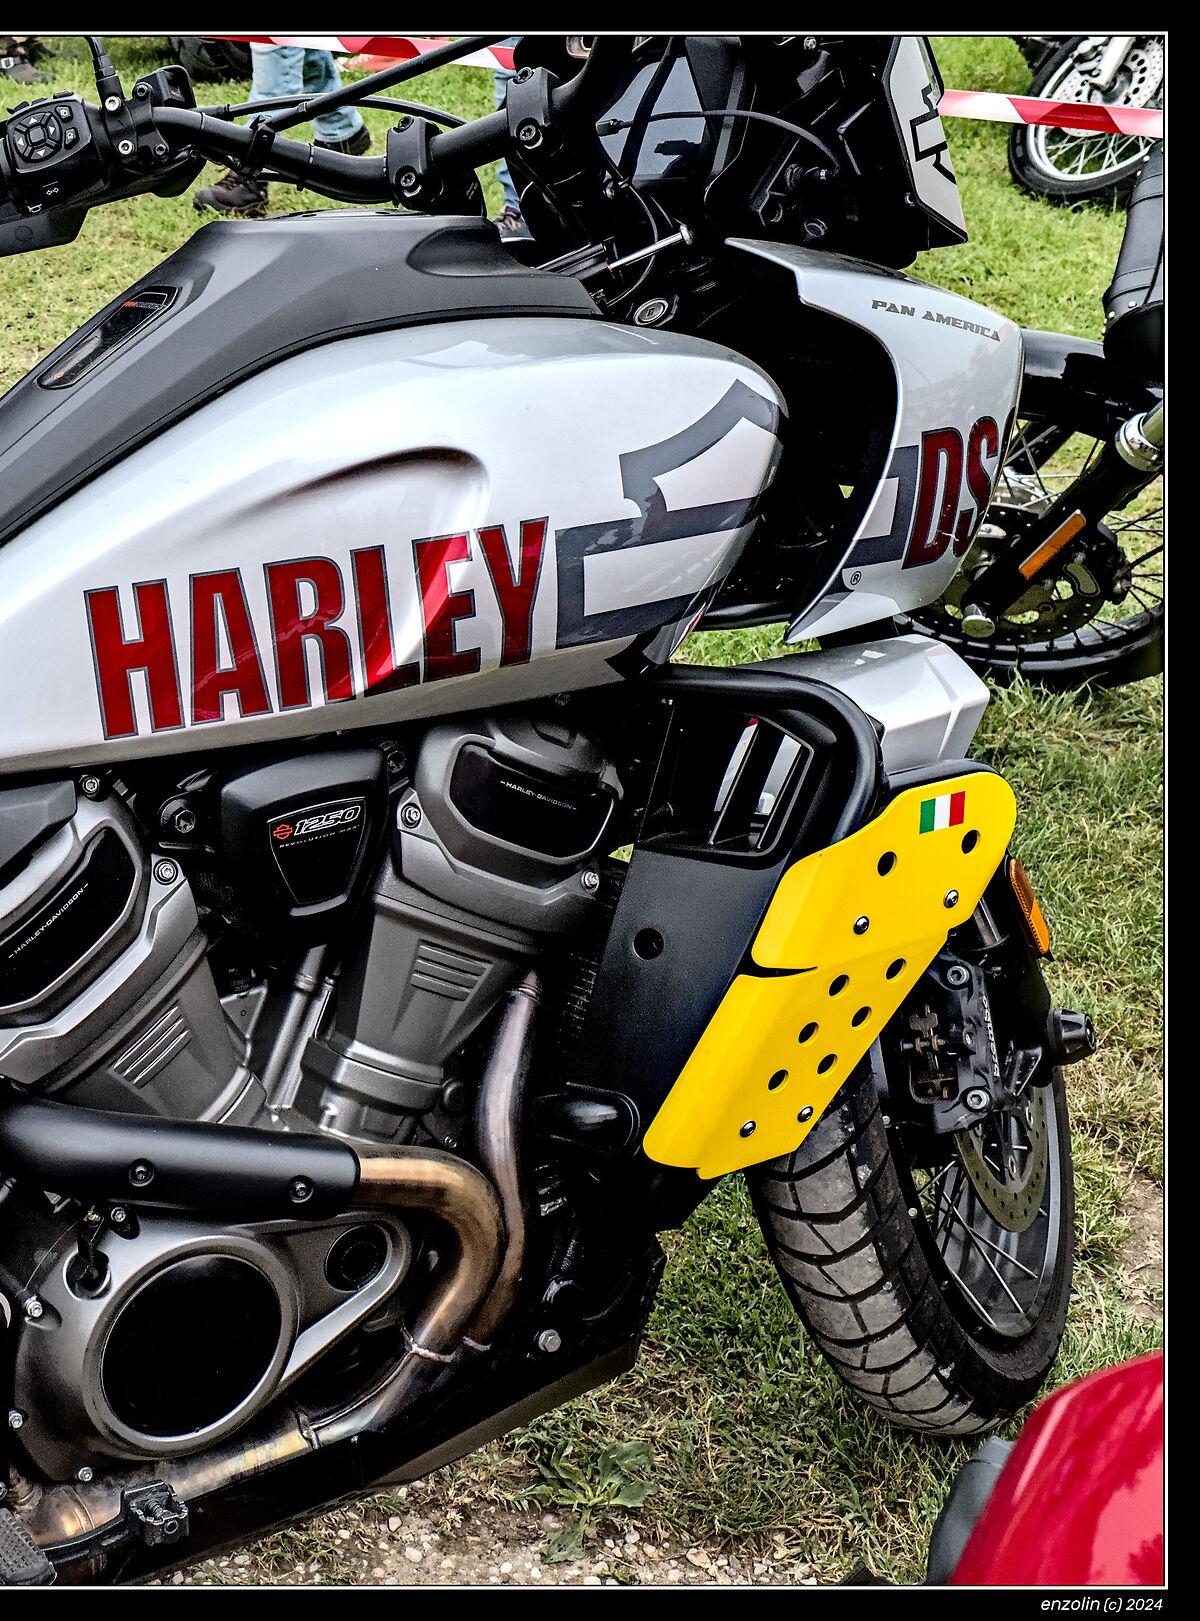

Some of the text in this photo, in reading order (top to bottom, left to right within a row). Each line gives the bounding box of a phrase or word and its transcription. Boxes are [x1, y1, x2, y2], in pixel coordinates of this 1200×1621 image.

[871, 299, 1001, 342] PAN AMERICA
[901, 406, 1017, 570] DS
[83, 516, 550, 740] HARLEY
[279, 831, 336, 848] REVOLUTION
[294, 806, 360, 836] 1250
